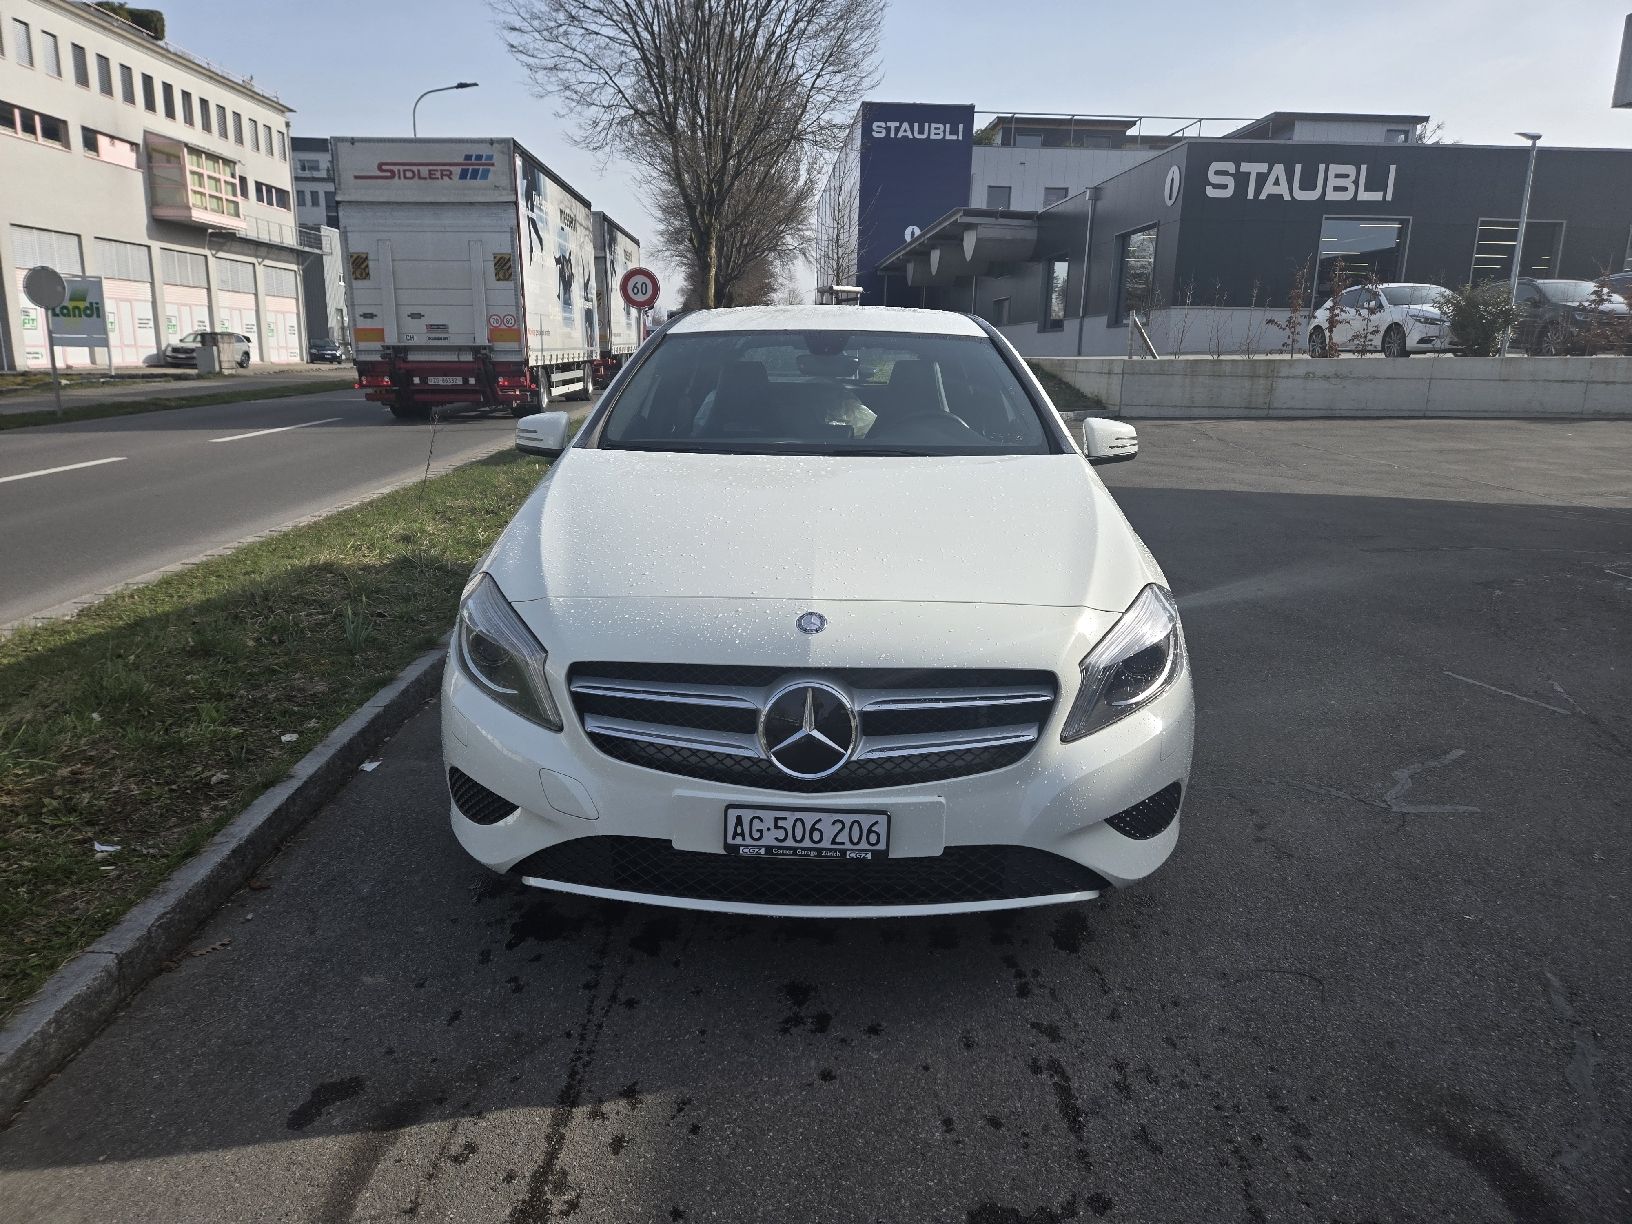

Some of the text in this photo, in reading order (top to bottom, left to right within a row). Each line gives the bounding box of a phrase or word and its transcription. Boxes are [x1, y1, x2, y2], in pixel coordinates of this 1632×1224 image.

[871, 121, 964, 142] STAUBLI
[353, 161, 454, 181] SIDLER
[1205, 161, 1397, 202] STAUBLI
[631, 281, 648, 296] 60
[796, 849, 818, 857] Garage
